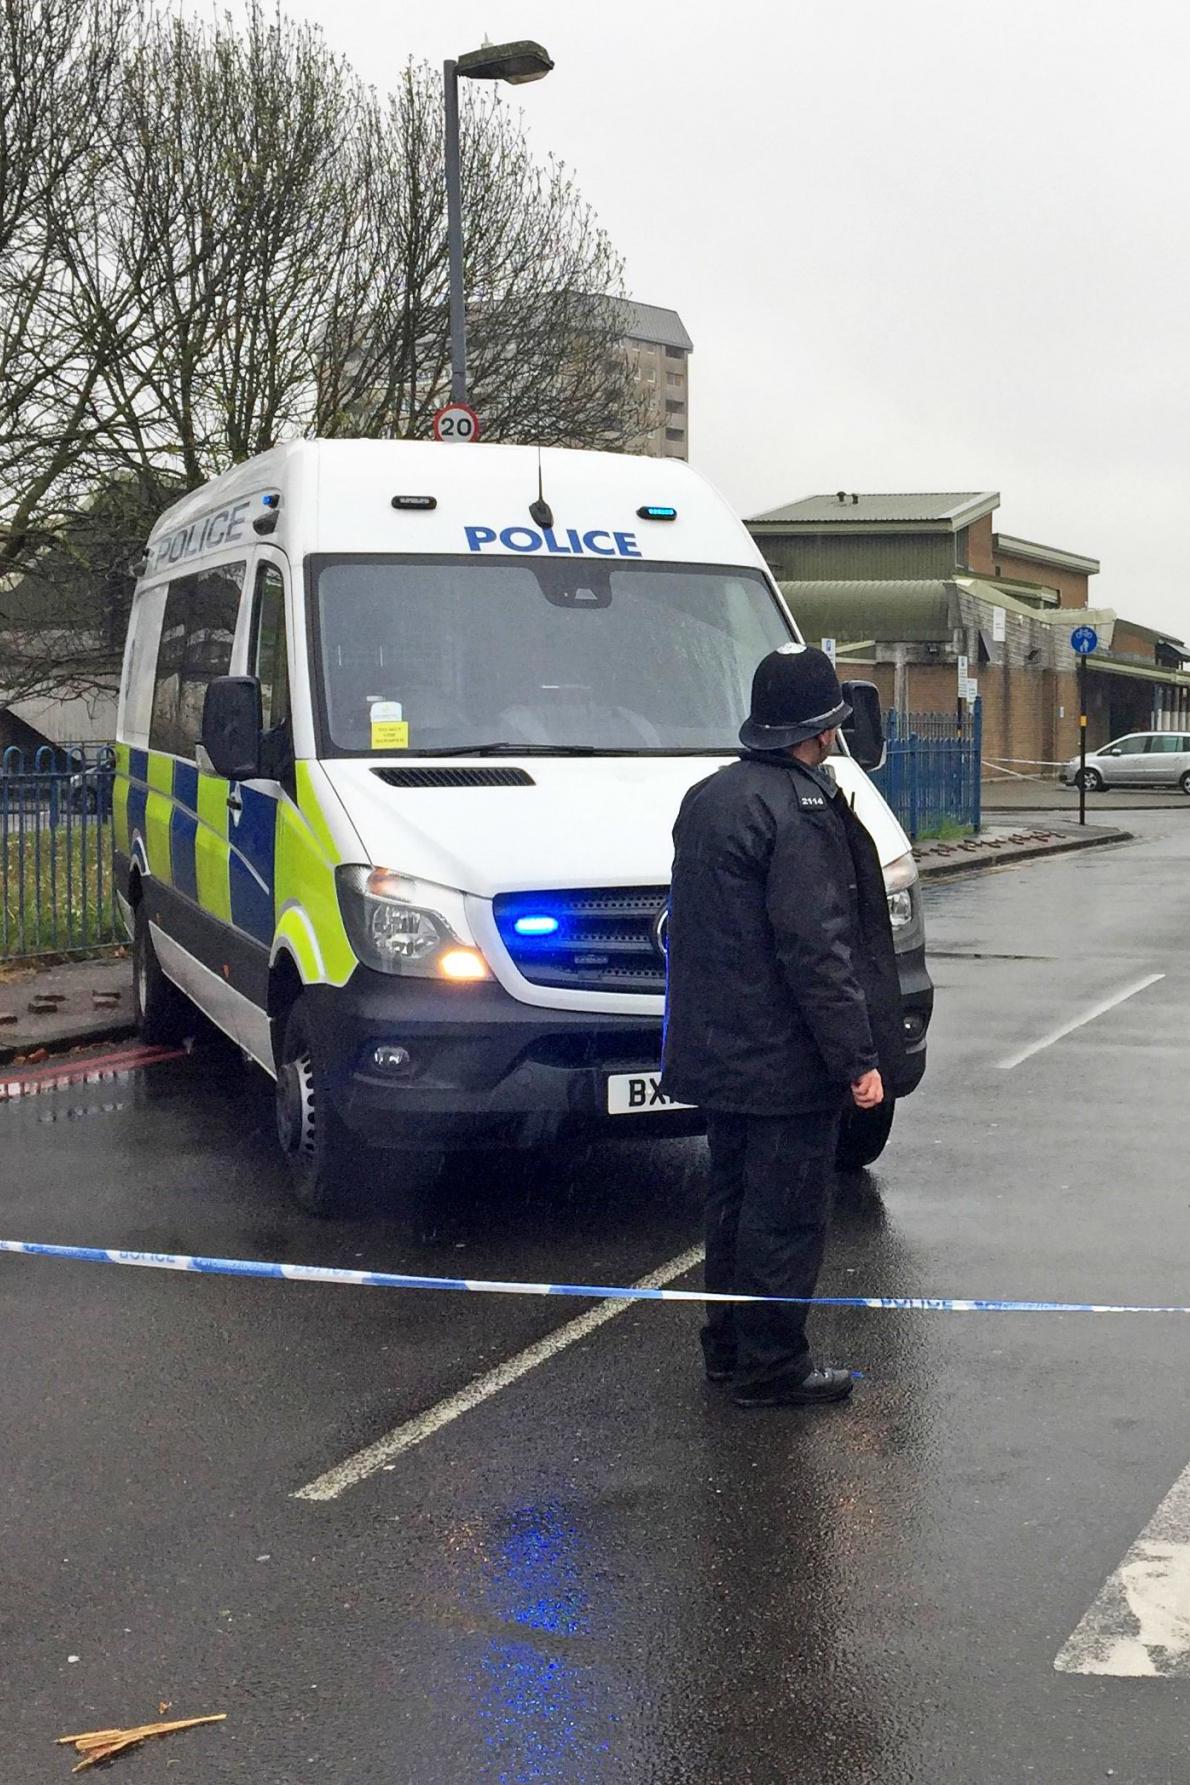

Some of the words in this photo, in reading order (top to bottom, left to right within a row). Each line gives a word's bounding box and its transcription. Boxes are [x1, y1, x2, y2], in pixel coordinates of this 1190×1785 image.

[441, 417, 472, 437] 20
[154, 501, 251, 570] POLICE
[464, 526, 642, 558] POLICE
[801, 797, 824, 805] 2114
